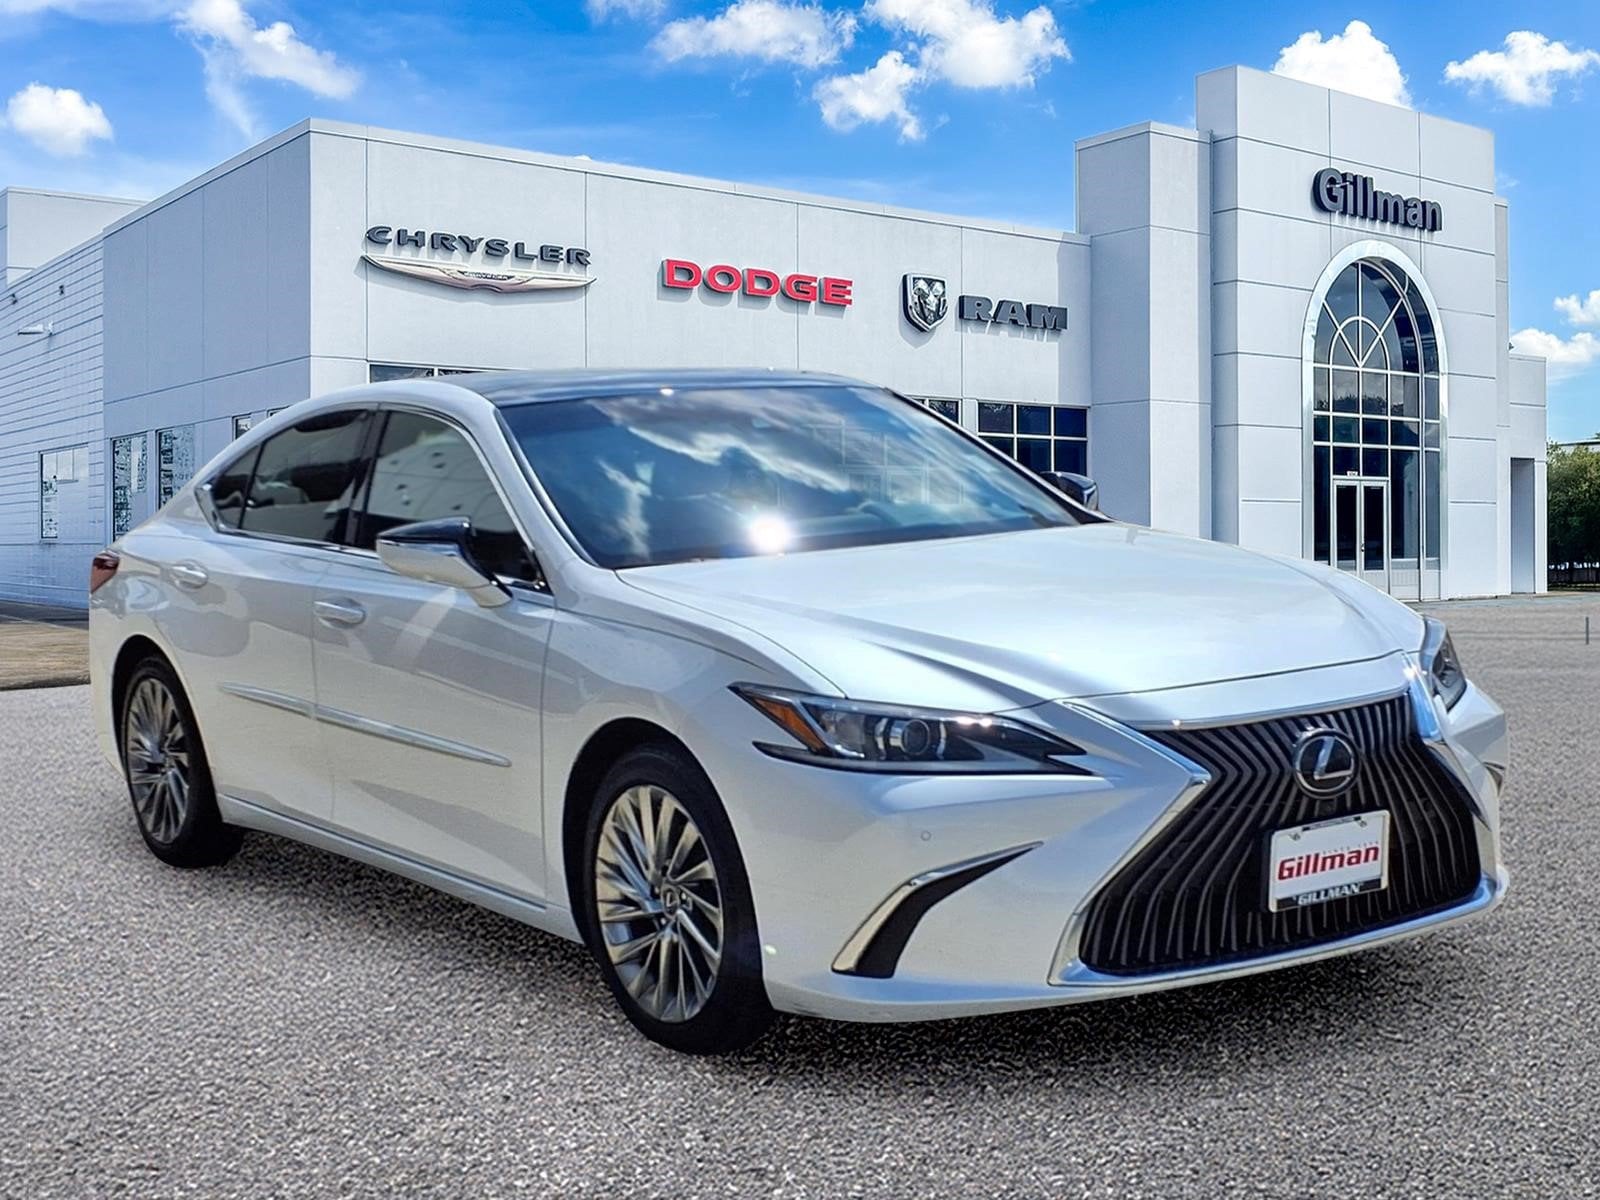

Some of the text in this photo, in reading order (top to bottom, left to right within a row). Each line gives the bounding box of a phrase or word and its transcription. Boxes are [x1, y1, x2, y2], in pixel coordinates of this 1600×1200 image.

[1312, 167, 1443, 231] Gillman
[366, 226, 591, 265] CHRYSLER
[661, 258, 853, 306] DODGE
[958, 295, 1068, 331] RAM
[1277, 846, 1380, 881] Gillman
[1298, 881, 1363, 905] GILLMAN
